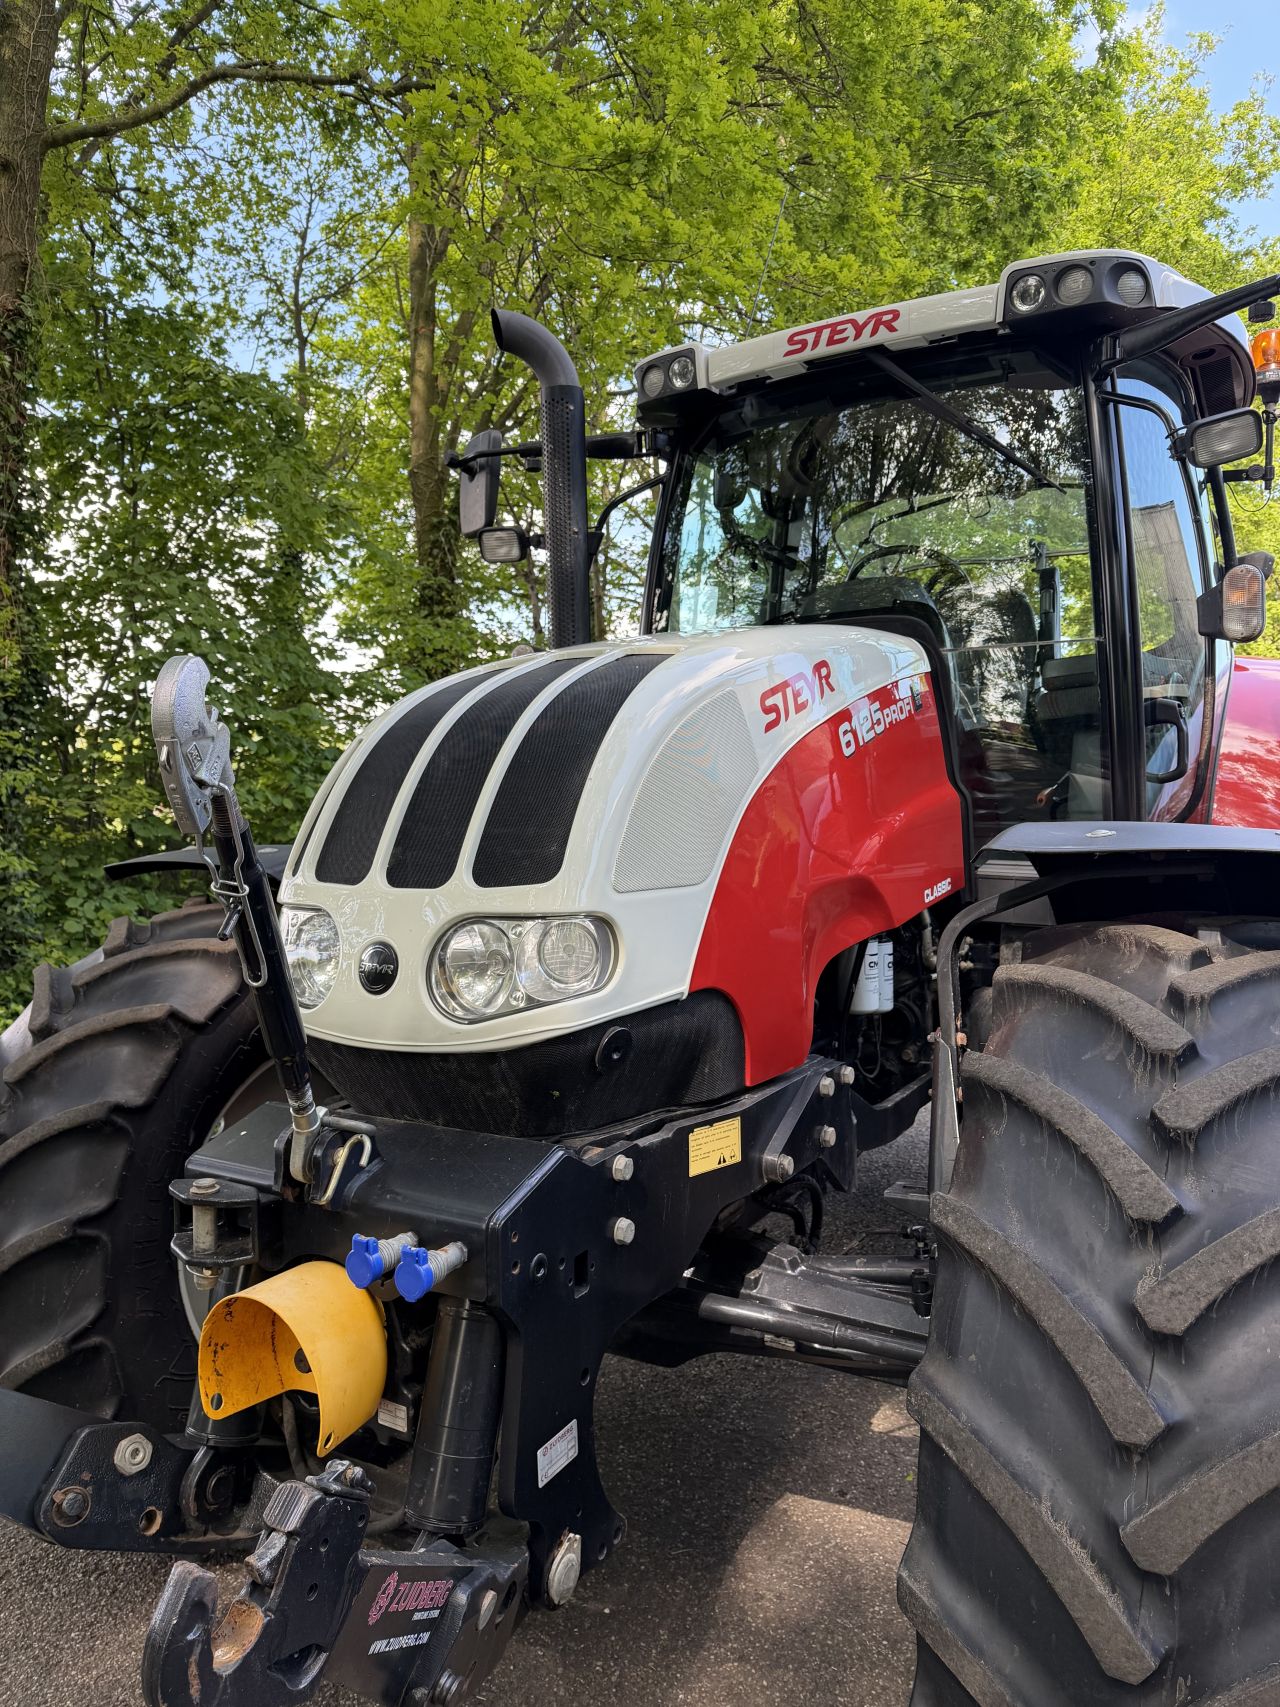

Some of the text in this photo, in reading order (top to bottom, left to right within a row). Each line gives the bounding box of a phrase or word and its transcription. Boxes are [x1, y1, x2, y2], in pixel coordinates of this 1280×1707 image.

[783, 309, 900, 357] STEYR
[760, 659, 836, 734] STEYR
[838, 696, 915, 758] 6125 PROFI
[924, 877, 952, 903] CLASSIC
[388, 1580, 454, 1612] ZUIDBERG
